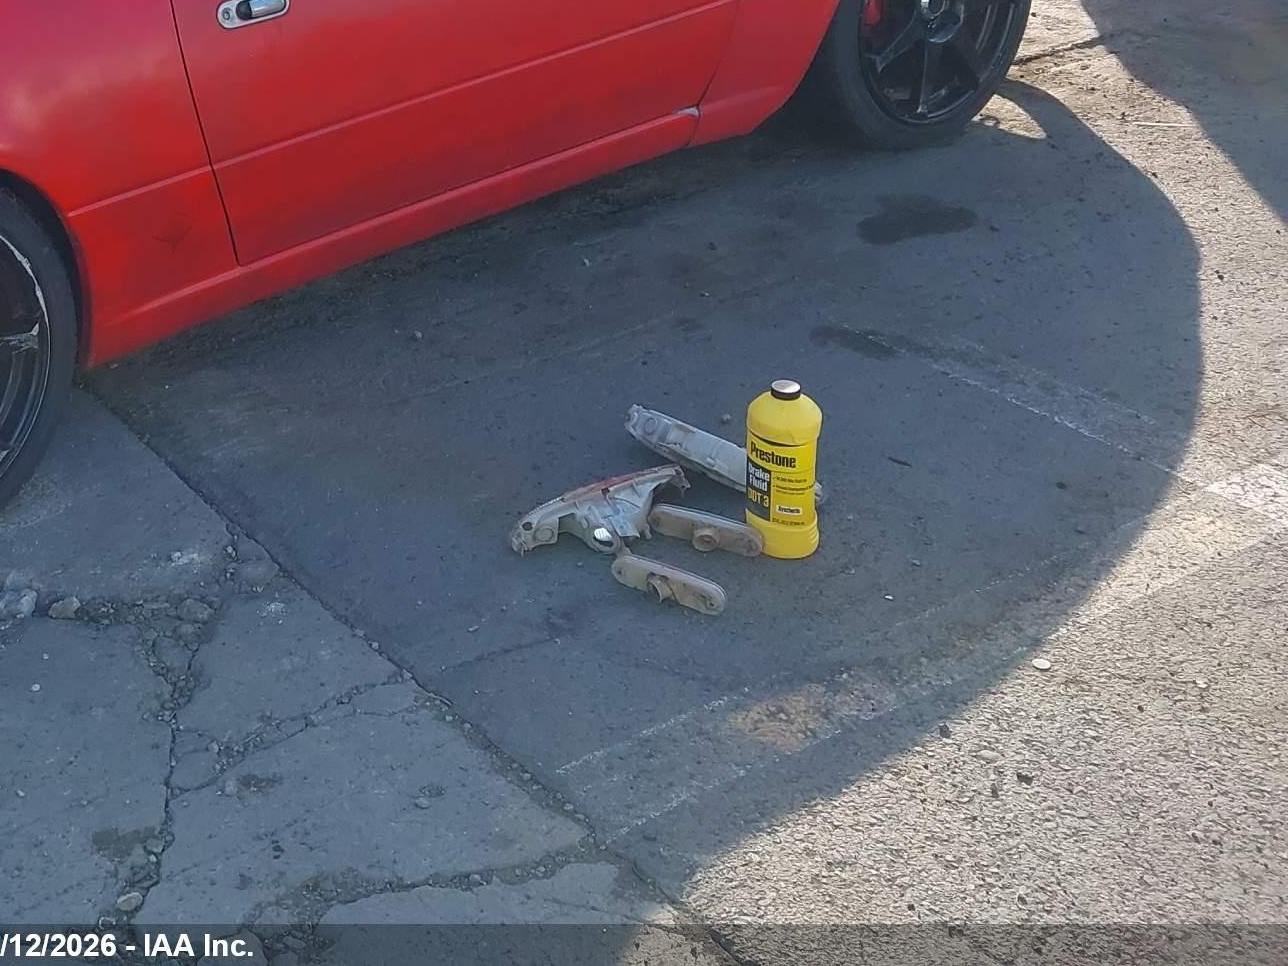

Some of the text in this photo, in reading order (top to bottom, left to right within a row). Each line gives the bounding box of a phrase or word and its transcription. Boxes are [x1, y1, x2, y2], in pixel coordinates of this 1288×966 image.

[751, 441, 796, 468] Prestone
[748, 462, 770, 482] Brake
[749, 474, 768, 492] Fluid
[748, 488, 769, 508] DOT 3
